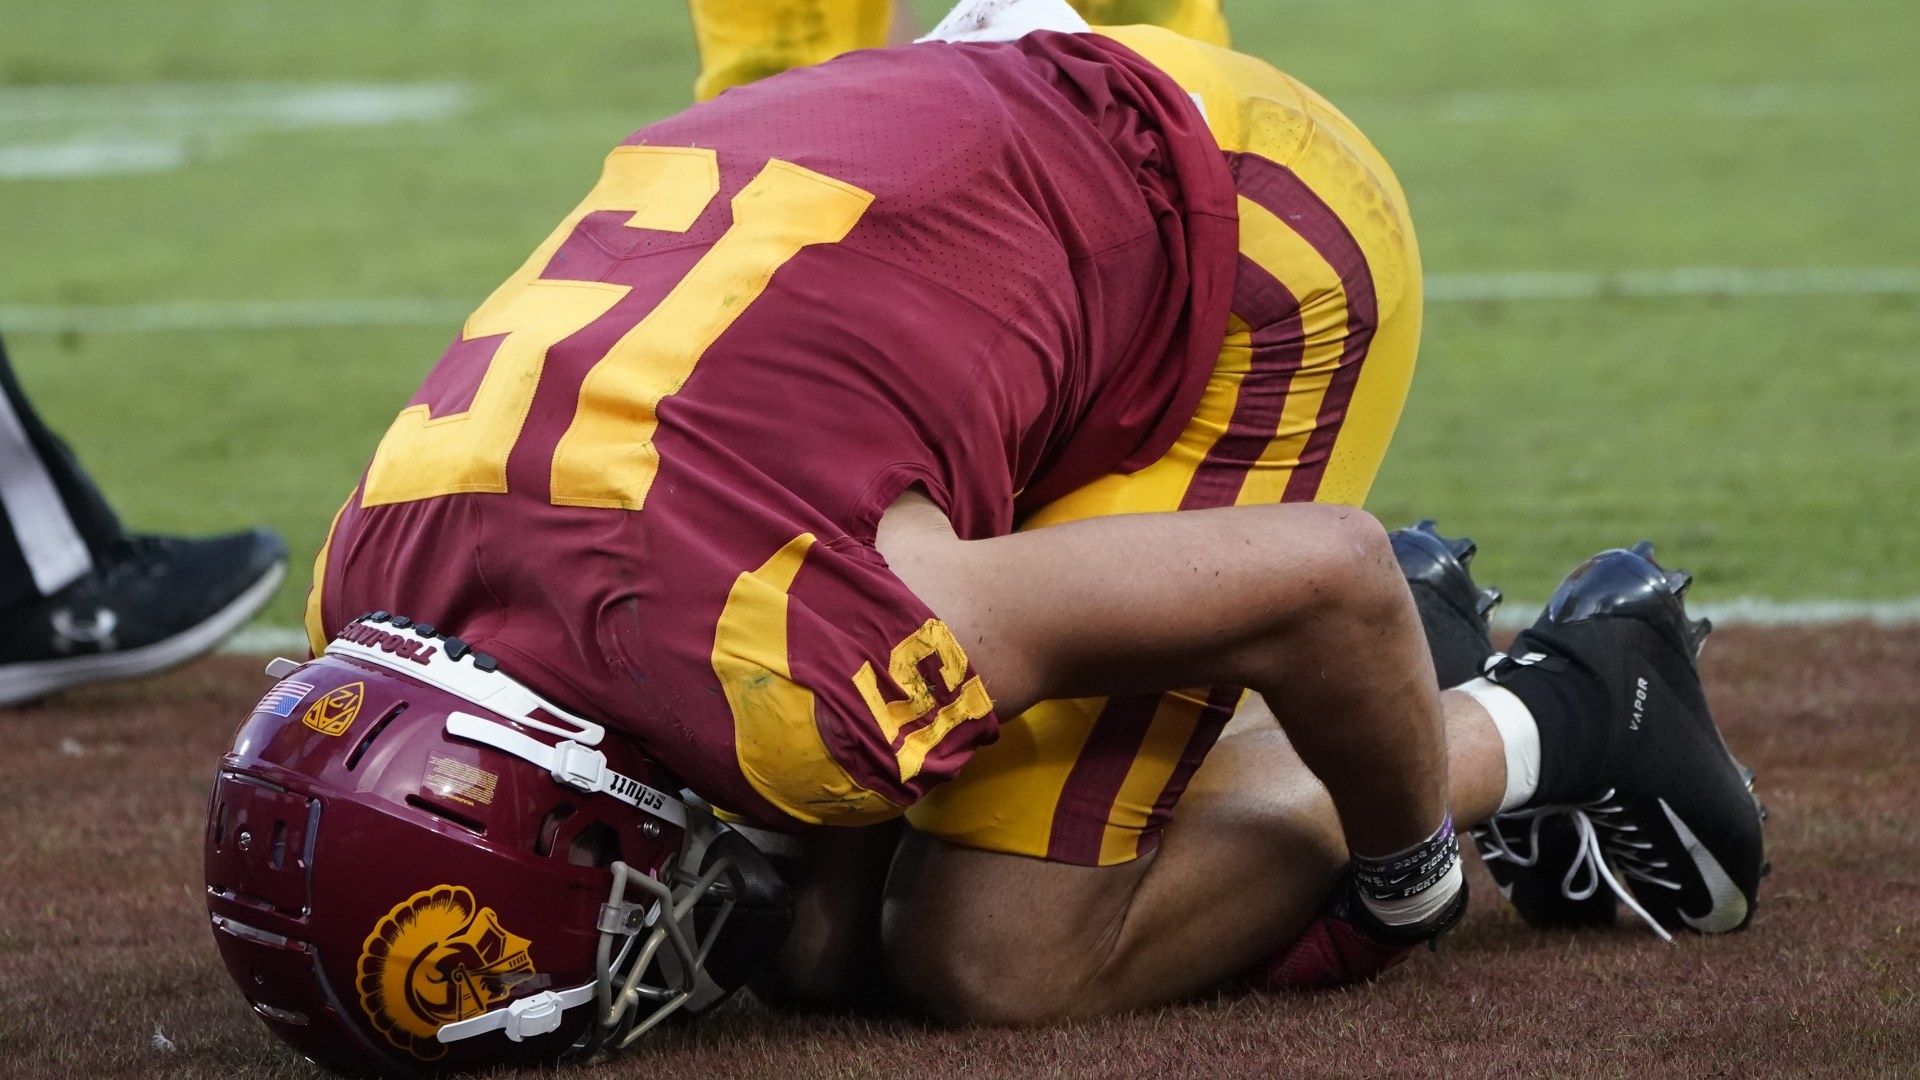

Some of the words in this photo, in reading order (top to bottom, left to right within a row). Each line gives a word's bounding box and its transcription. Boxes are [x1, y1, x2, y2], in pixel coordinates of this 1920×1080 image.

[362, 146, 875, 511] 15
[337, 622, 437, 666] TROJANS
[851, 618, 993, 784] 15
[1629, 677, 1648, 731] VAPOR
[610, 774, 663, 811] schutt
[1421, 844, 1448, 874] FIGHT
[1404, 873, 1437, 897] FIGHT
